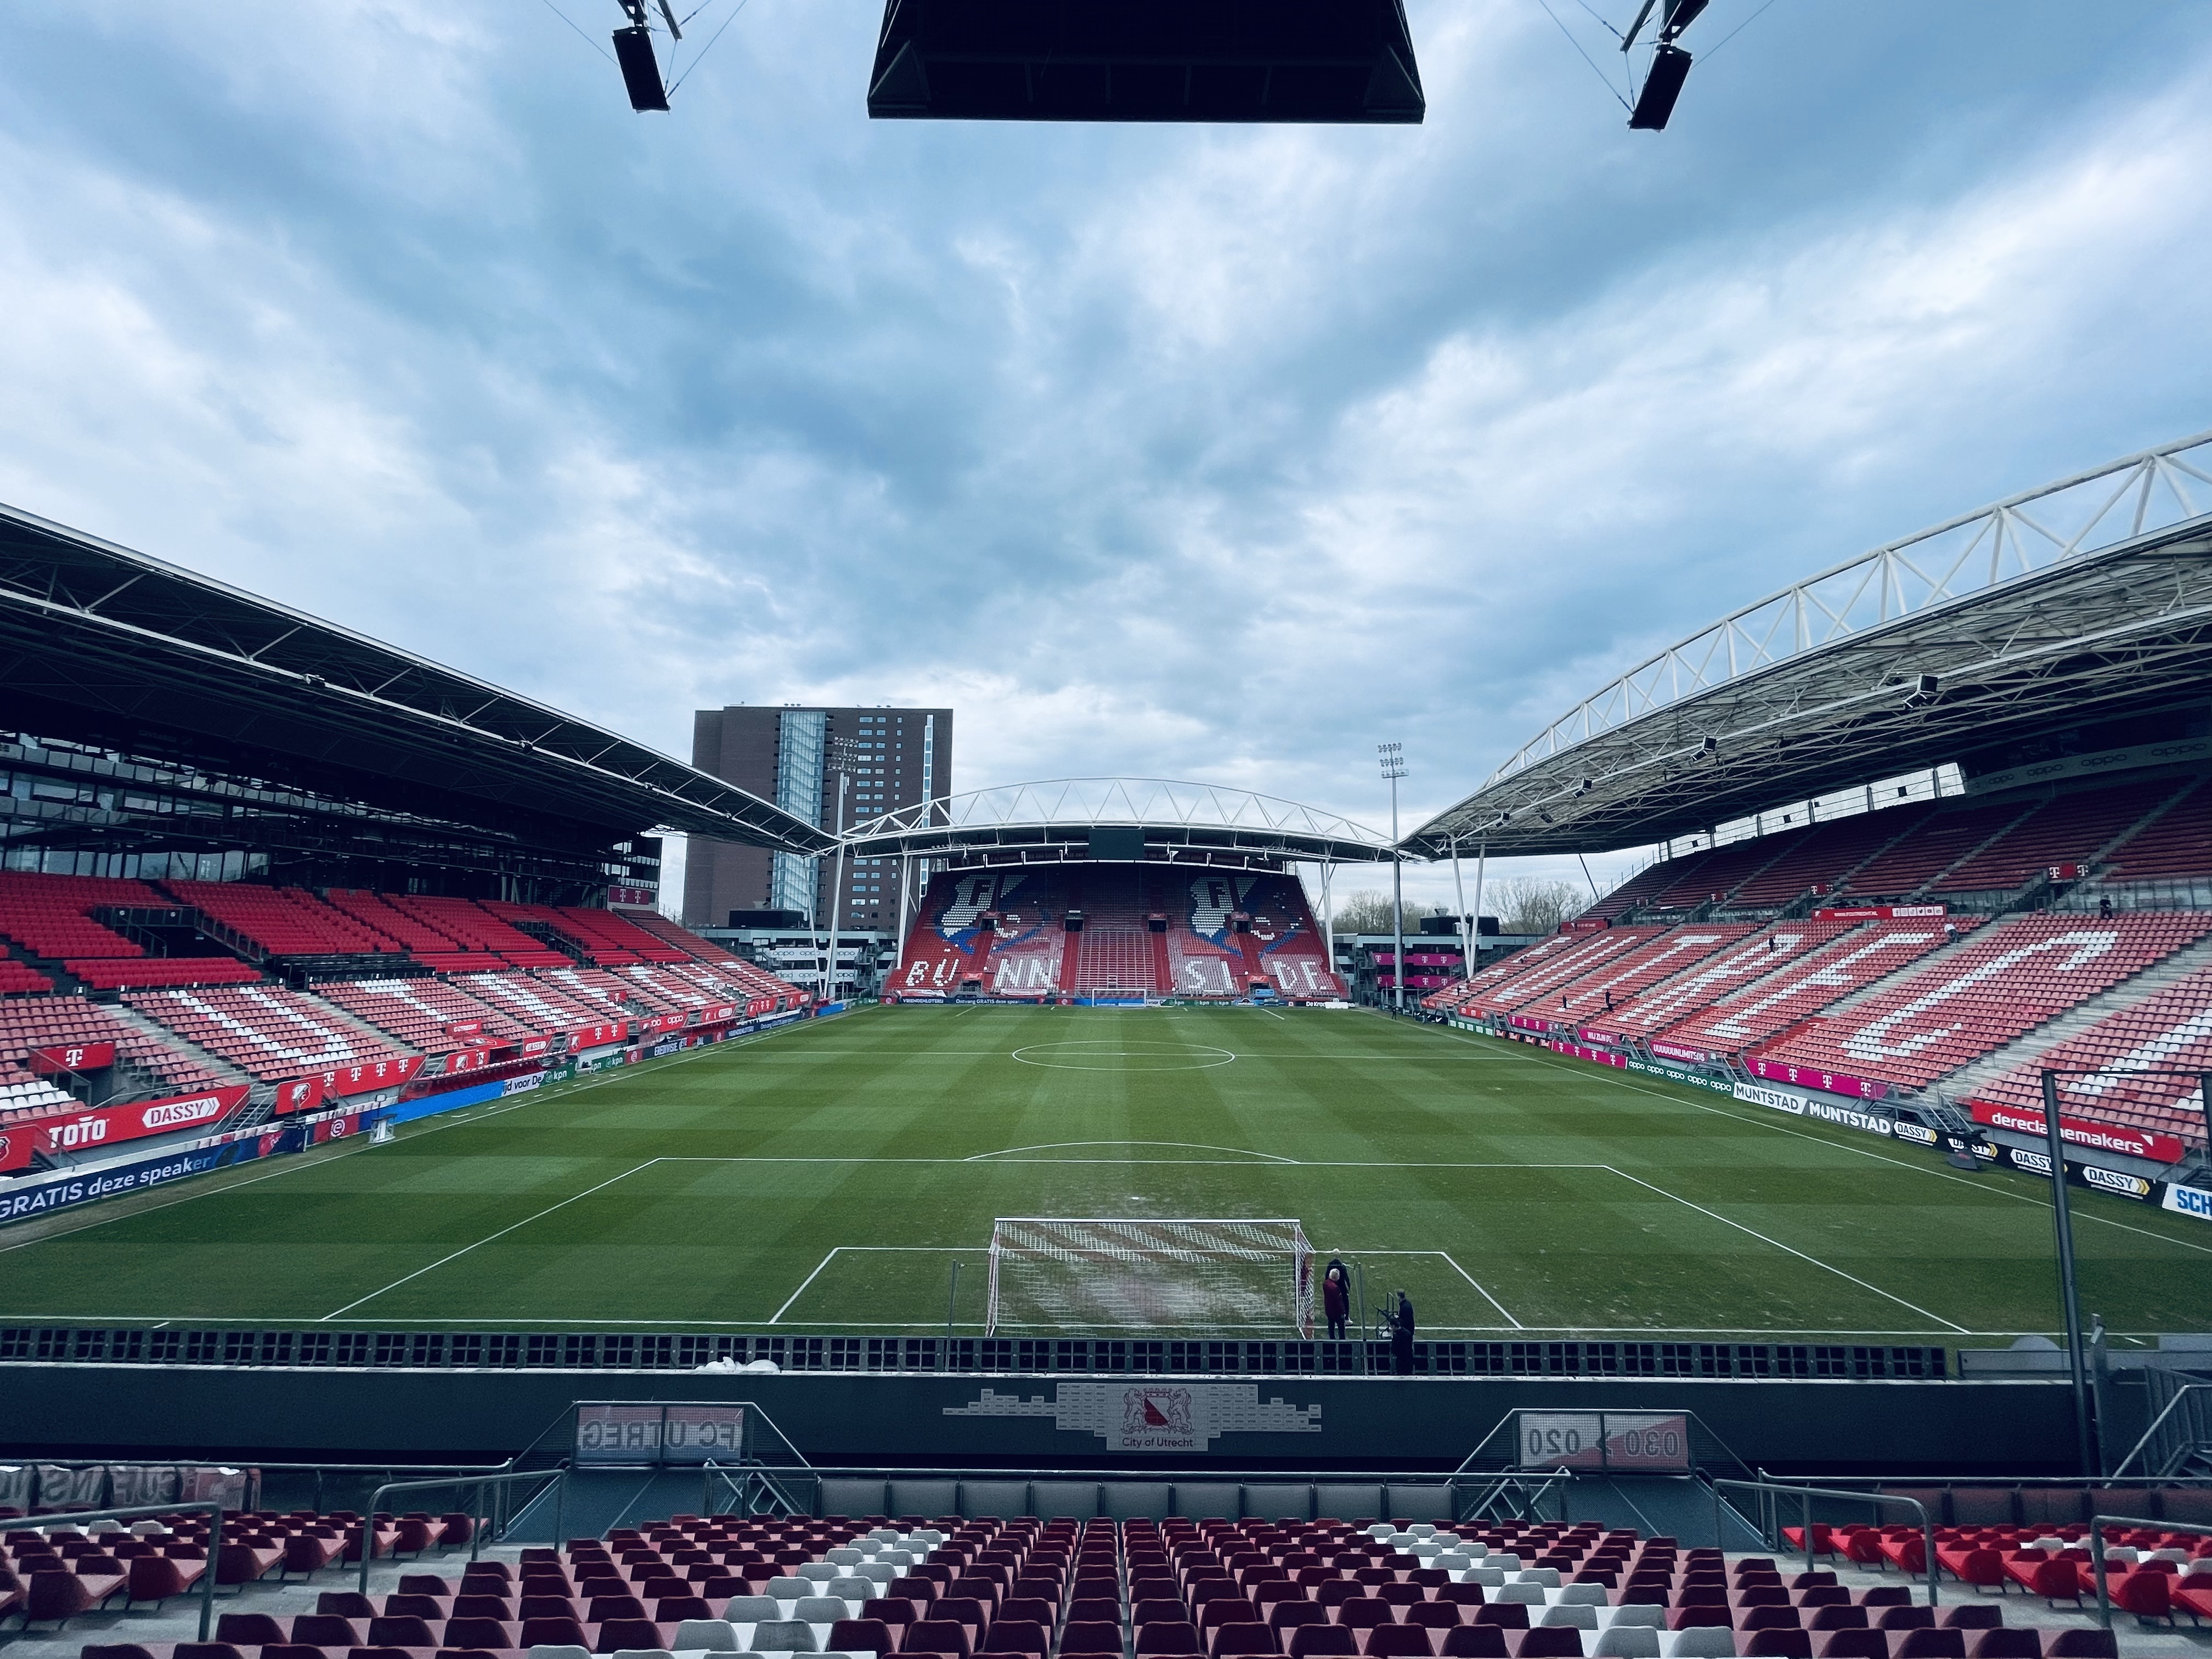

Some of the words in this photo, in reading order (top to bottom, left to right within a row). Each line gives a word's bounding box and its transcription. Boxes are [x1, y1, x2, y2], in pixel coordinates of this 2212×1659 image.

[2152, 743, 2207, 758] oppo
[2081, 754, 2127, 767] oppo
[612, 1057, 623, 1066] kpn
[1629, 1060, 1645, 1070] oppo
[554, 1070, 567, 1081] kpn
[1647, 1065, 1664, 1075] oppo
[1667, 1069, 1685, 1080] oppo
[514, 1079, 531, 1089] voor
[532, 1076, 541, 1085] De
[1688, 1074, 1707, 1086] oppo
[1710, 1080, 1731, 1092] oppo
[1736, 1084, 1798, 1110] MUNTSTAD
[150, 1101, 205, 1125] DASSY
[1810, 1102, 1891, 1134] MUNTSTAD
[48, 1116, 106, 1149] TOTO
[1898, 1123, 1926, 1138] DASSY
[1992, 1113, 2144, 1154] dereclaemakers
[88, 1177, 135, 1195] deze
[139, 1156, 211, 1186] speaker
[2089, 1169, 2133, 1190] DASSY
[1122, 1437, 1142, 1448] City
[1144, 1437, 1154, 1447] of
[1157, 1437, 1194, 1447] Utrecht
